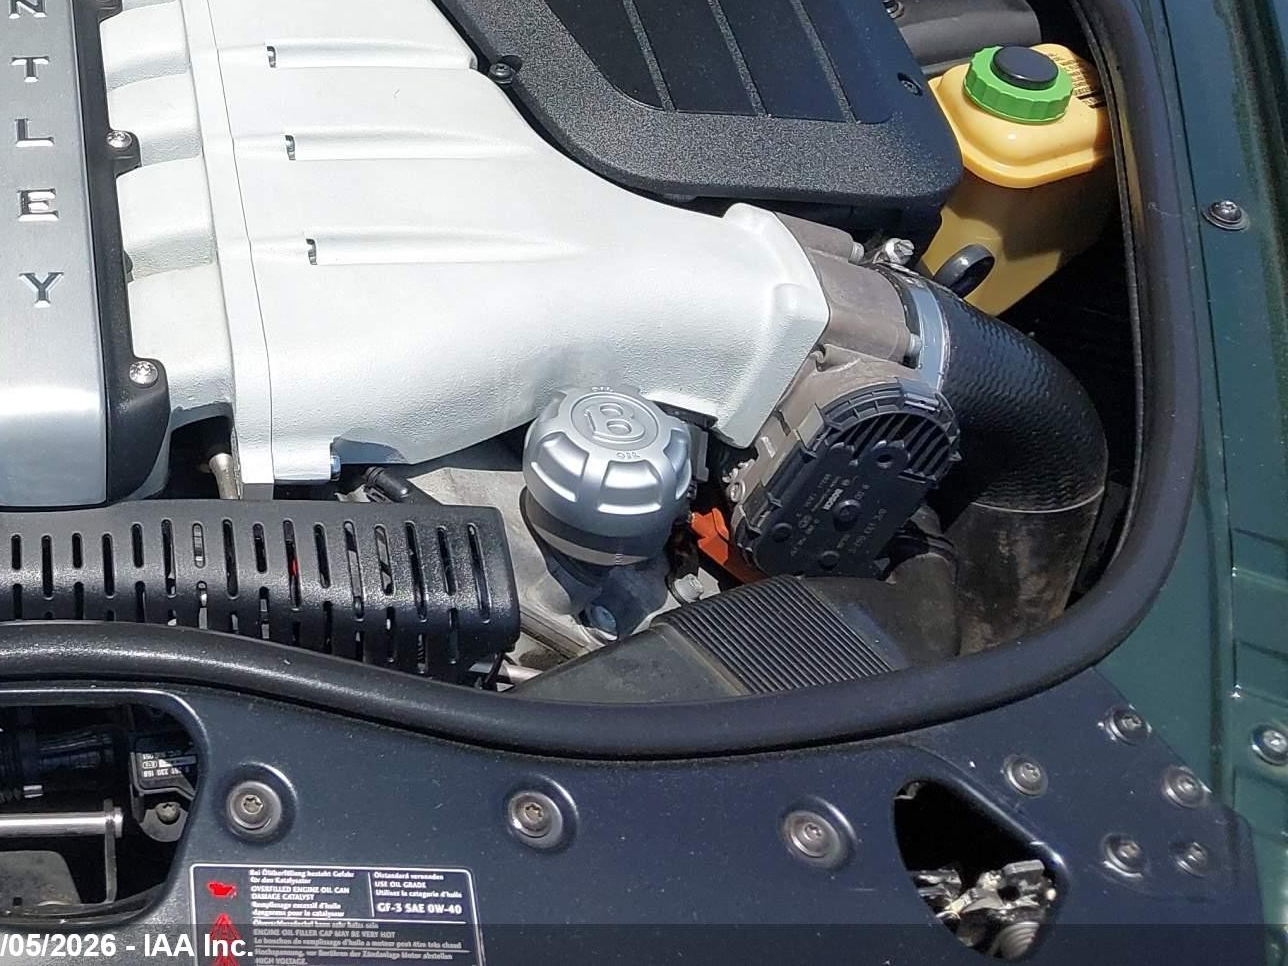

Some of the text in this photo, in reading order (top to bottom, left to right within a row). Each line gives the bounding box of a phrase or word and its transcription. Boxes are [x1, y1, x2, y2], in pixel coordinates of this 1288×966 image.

[376, 902, 463, 915] GF-3 SAE 0W-40
